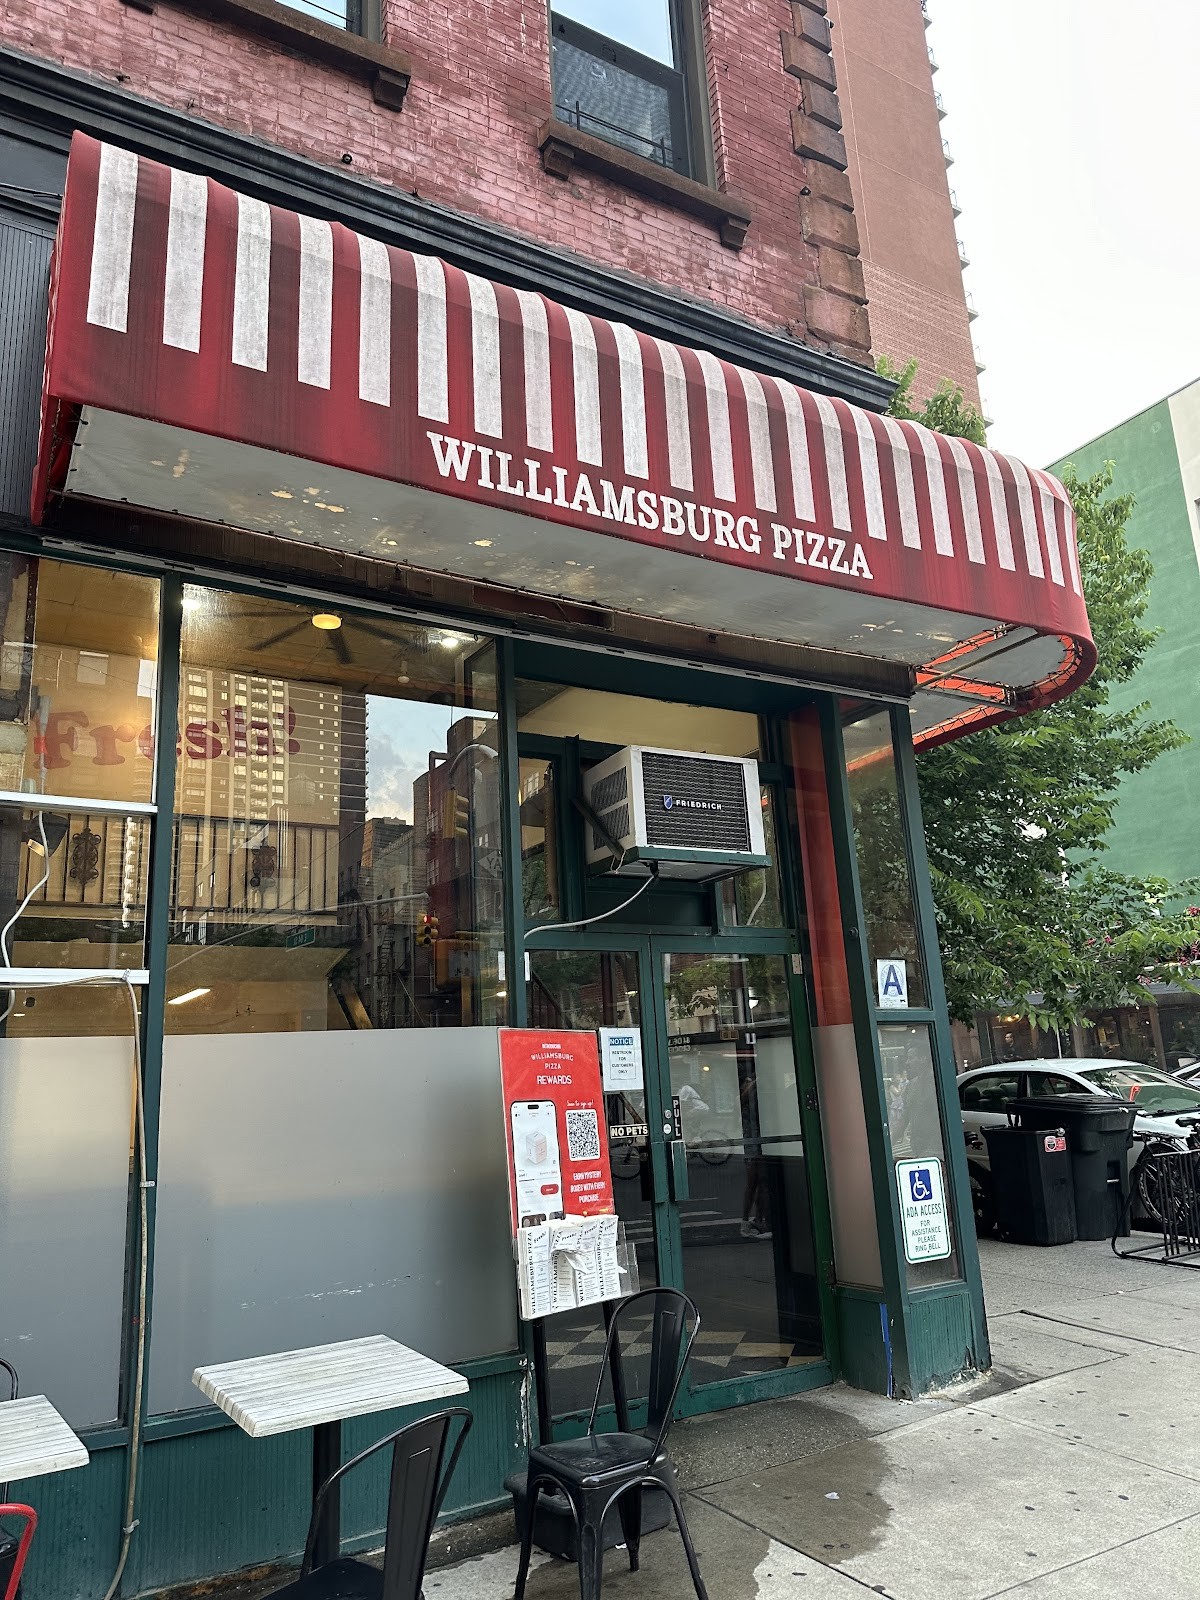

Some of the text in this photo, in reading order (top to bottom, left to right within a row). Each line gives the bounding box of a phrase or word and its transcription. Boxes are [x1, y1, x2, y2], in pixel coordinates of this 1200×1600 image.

[426, 431, 875, 580] WILLIAMSBURG PIZZA
[676, 799, 722, 810] FRIEDRICH
[883, 965, 903, 995] A
[610, 1037, 634, 1045] NOTICE
[531, 1052, 574, 1061] WILLIAMSBURG
[544, 1062, 562, 1070] PIZZA
[536, 1074, 572, 1085] REWARDS
[672, 1099, 681, 1137] PULL
[611, 1125, 648, 1137] NO PETS
[906, 1202, 942, 1218] ADA ACCESS
[911, 1225, 942, 1236] ASSISTANCE
[917, 1234, 937, 1243] PLEASE
[928, 1242, 941, 1251] BELL
[596, 1242, 605, 1298] WILLIAMSBURG
[528, 1255, 536, 1315] WILLIAMSBURG
